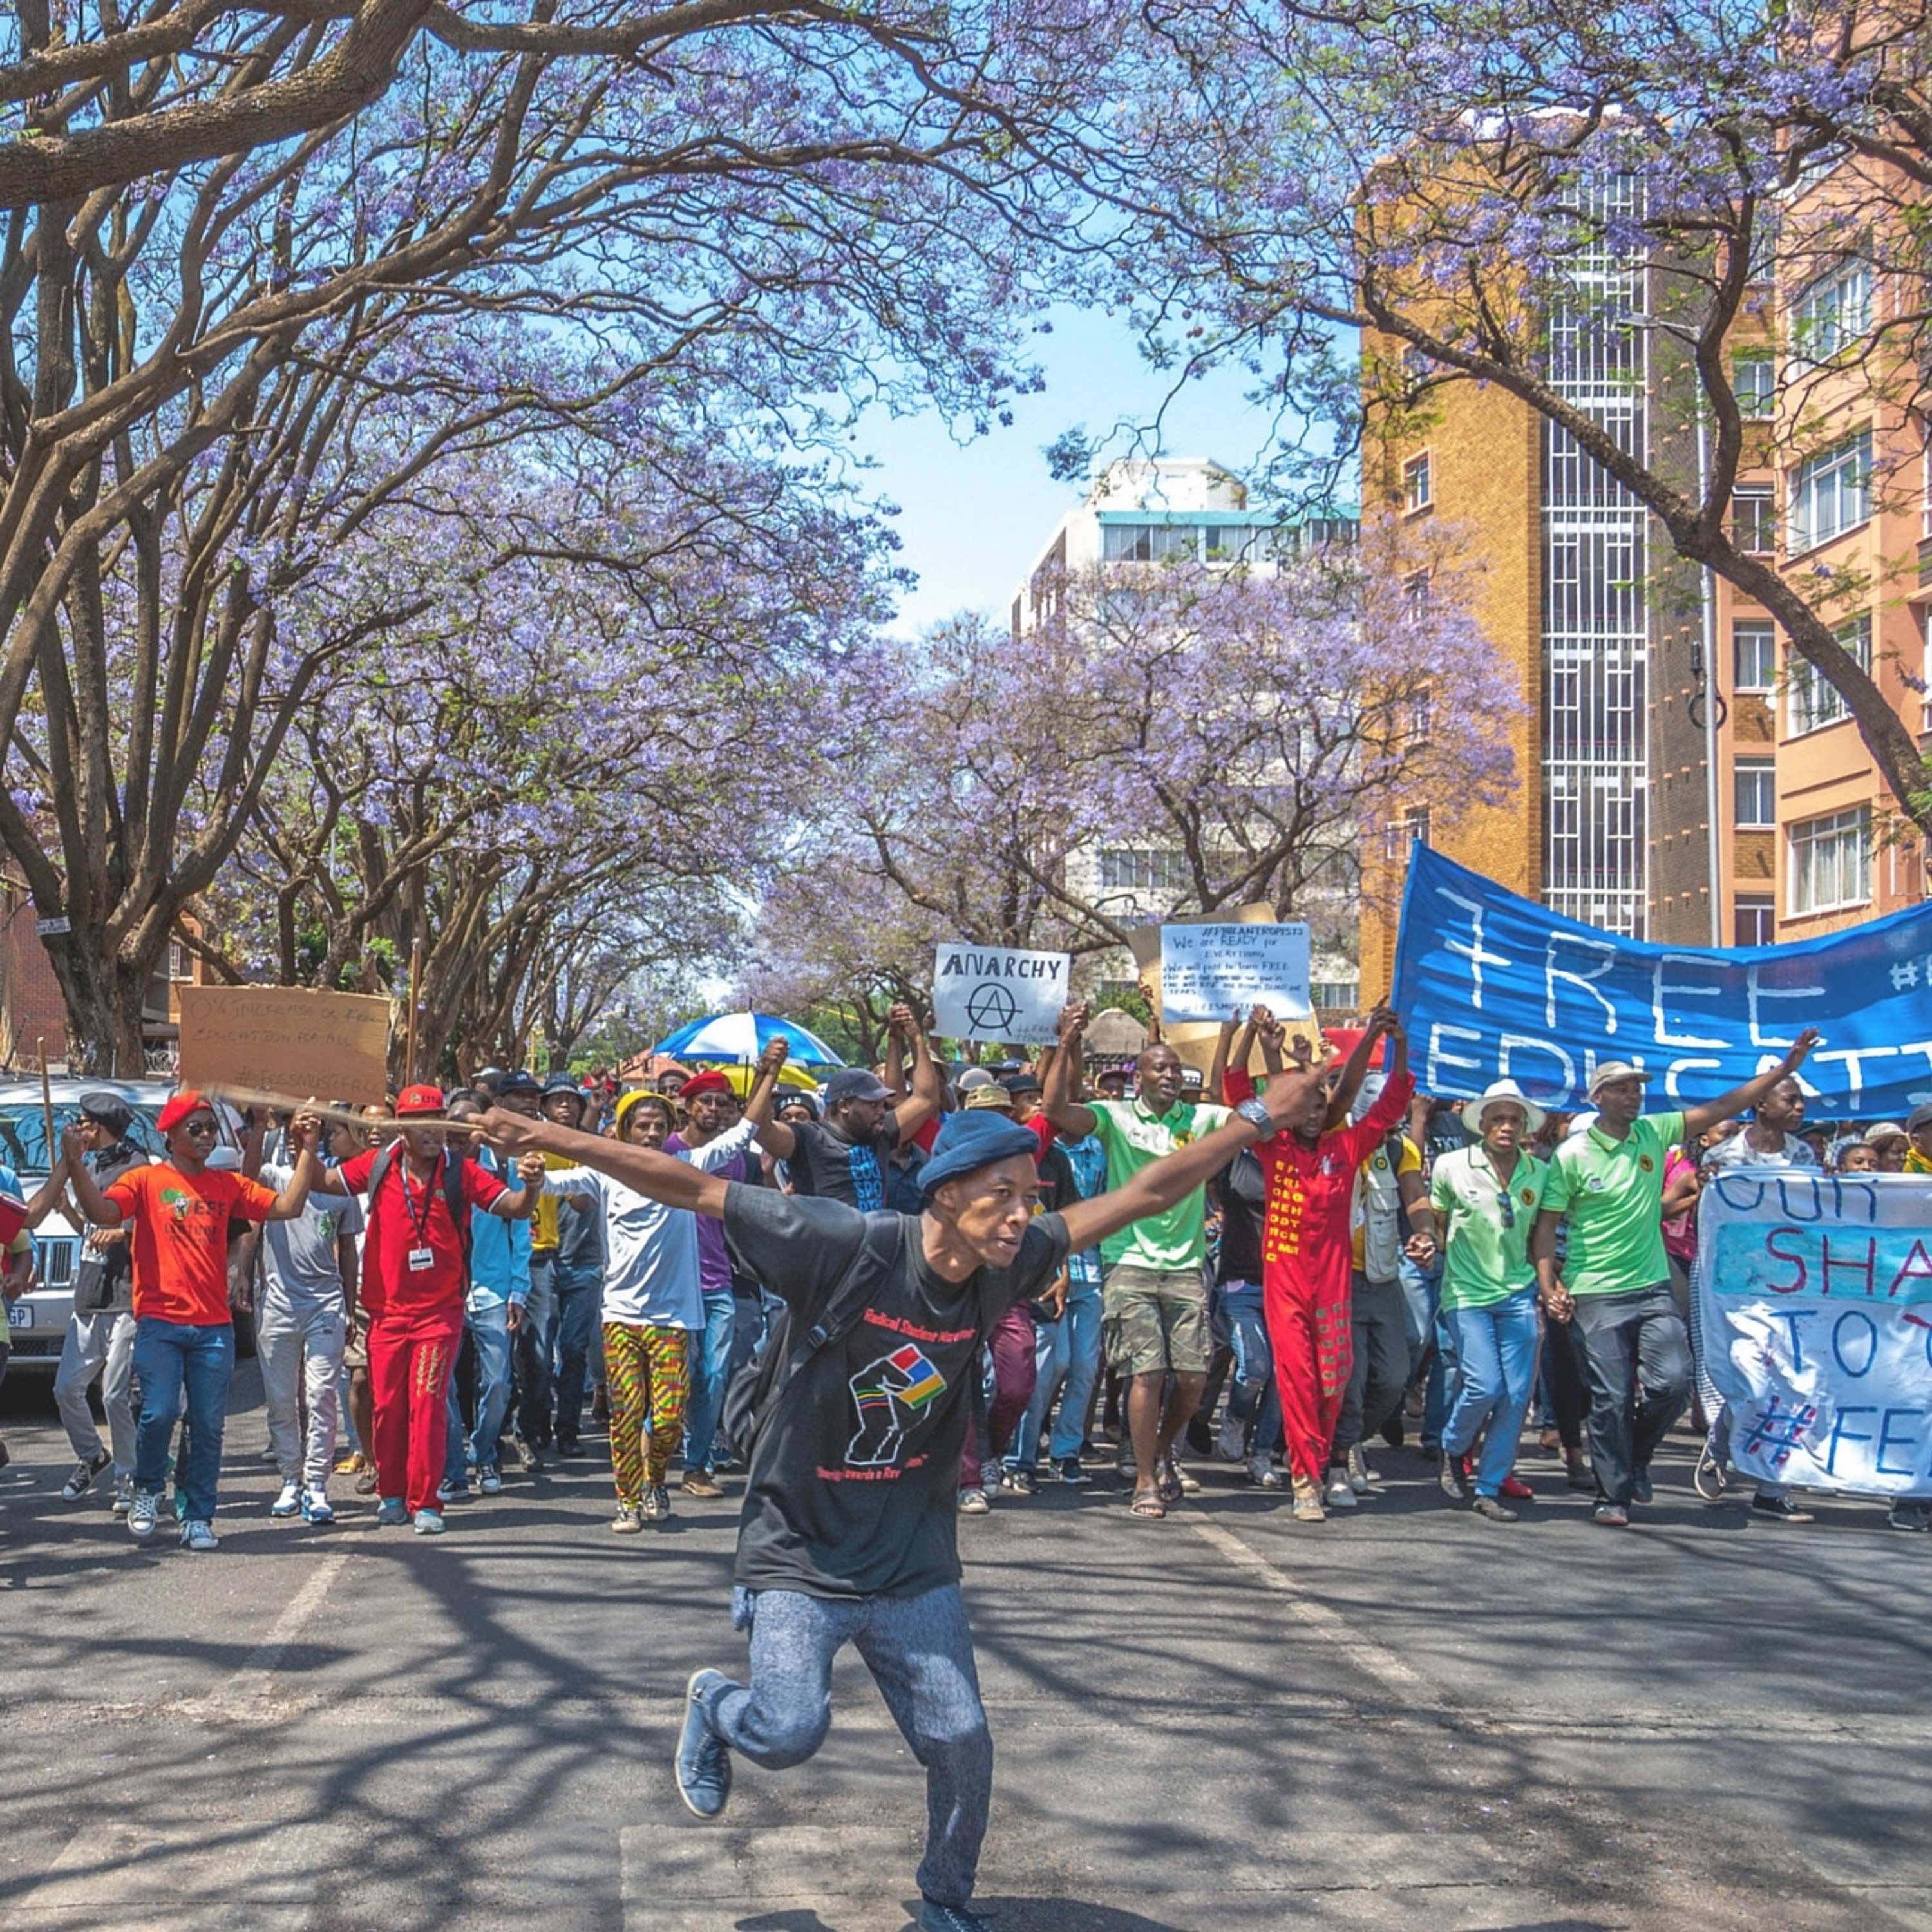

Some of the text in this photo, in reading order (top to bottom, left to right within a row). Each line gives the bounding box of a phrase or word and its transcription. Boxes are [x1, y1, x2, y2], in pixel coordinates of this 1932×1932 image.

[941, 953, 1061, 980] ANARCHY
[1173, 936, 1193, 949] We
[1220, 936, 1257, 946] READY
[1435, 887, 1829, 1049] FREE
[8, 1308, 26, 1325] GP
[1769, 1309, 1877, 1378] TO
[1742, 1394, 1932, 1479] #FE
